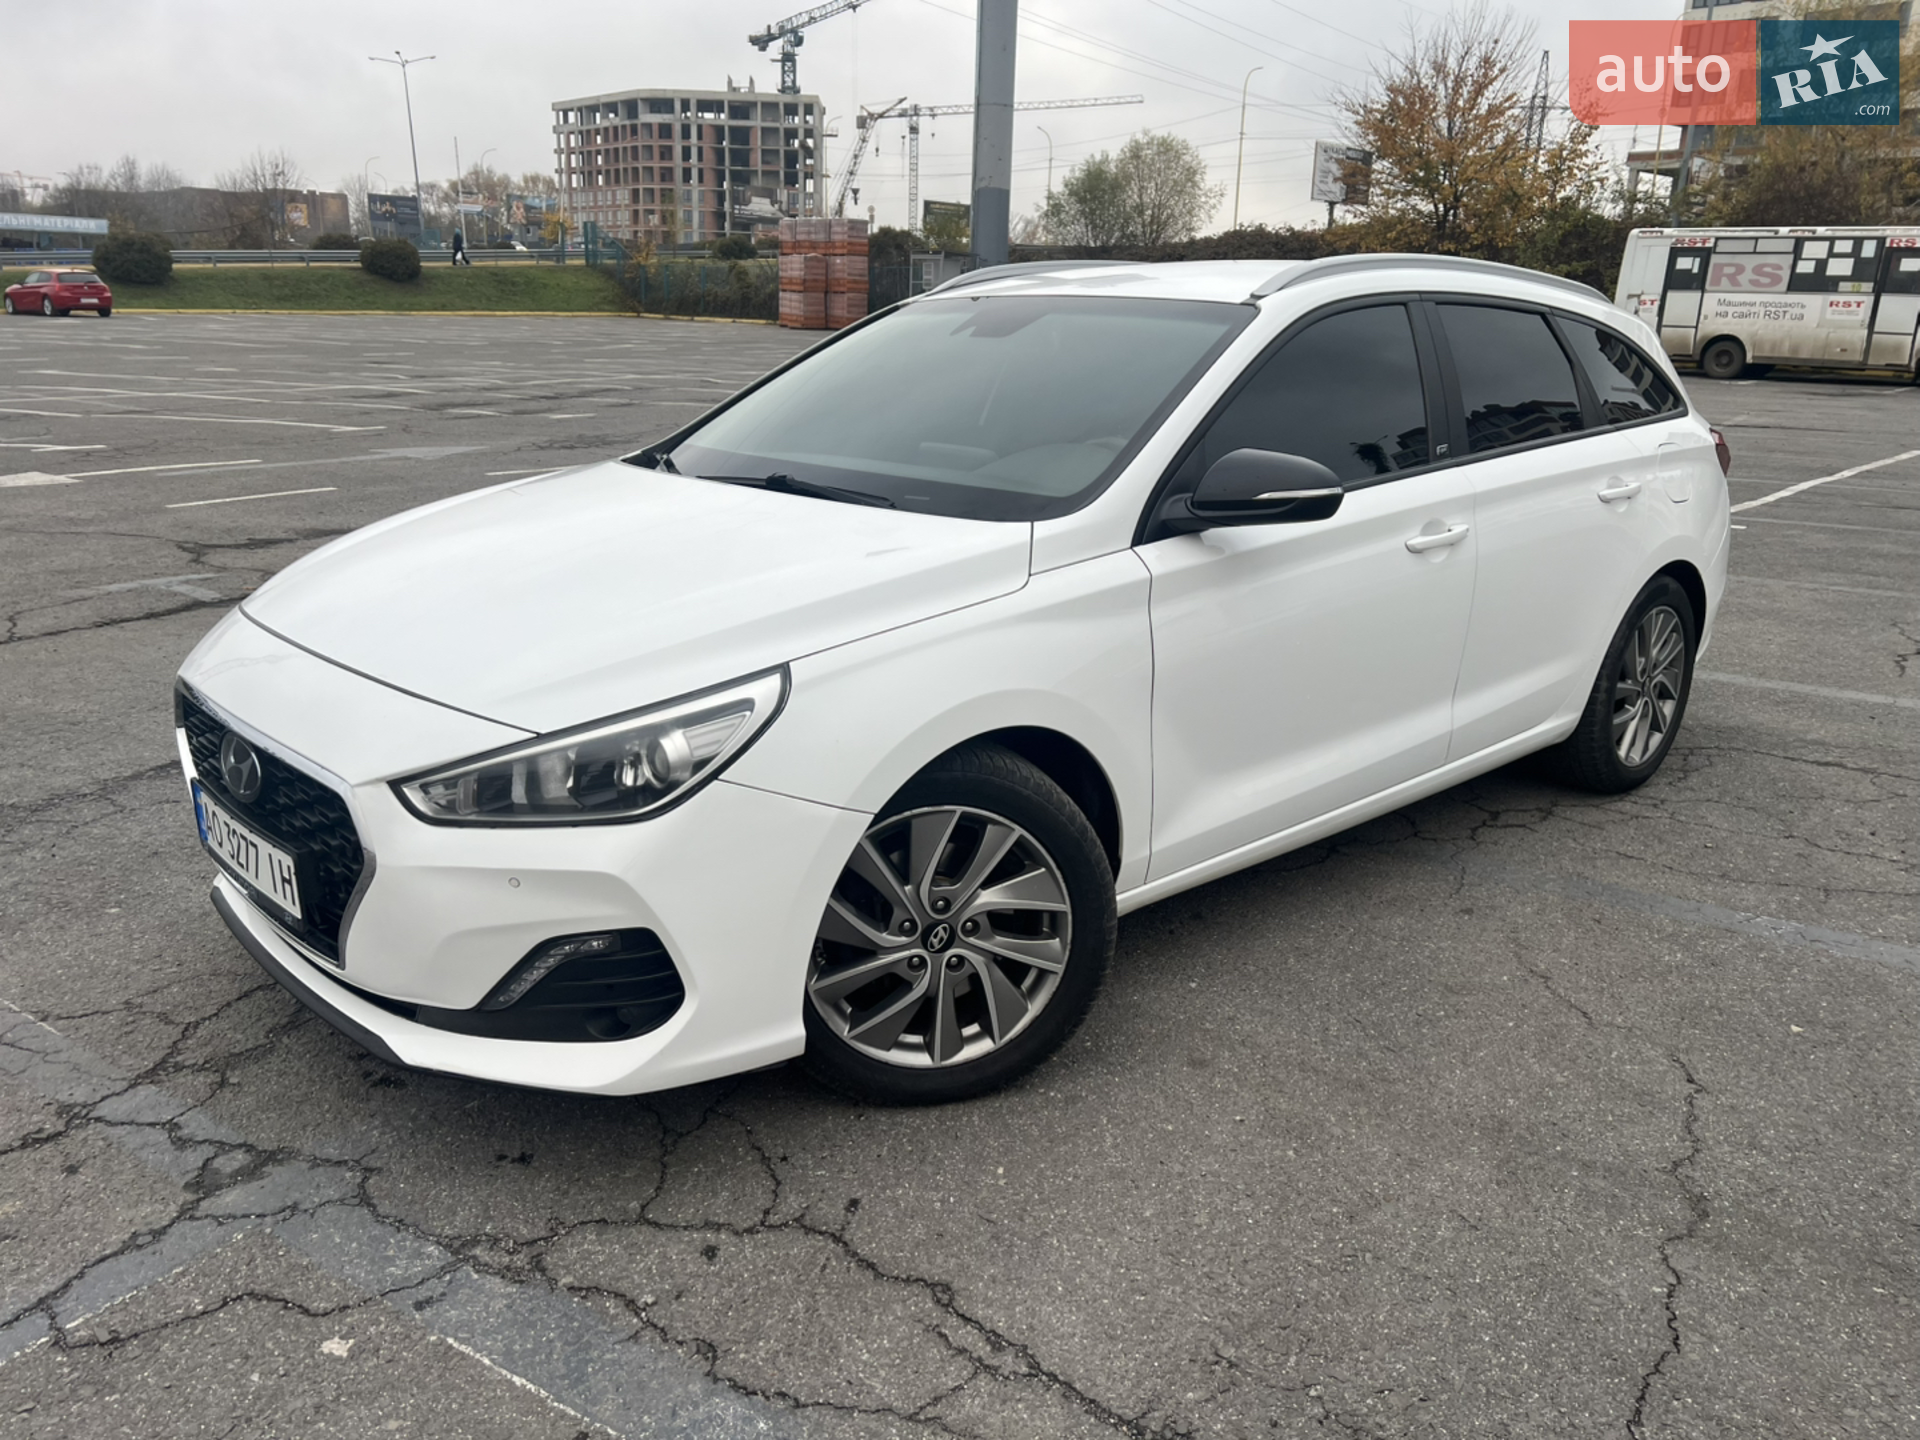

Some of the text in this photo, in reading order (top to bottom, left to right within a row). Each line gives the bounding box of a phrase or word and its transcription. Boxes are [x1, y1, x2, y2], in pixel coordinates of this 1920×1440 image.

[0, 214, 97, 230] ЛЬНІ МАТЕРІАЛИ
[1708, 262, 1784, 289] RS
[1716, 298, 1807, 309] Машини продають
[1829, 300, 1865, 308] RST
[1715, 309, 1805, 321] на сайті RST.ua
[204, 802, 223, 849] AO
[223, 820, 259, 880] 3277
[268, 852, 296, 907] IH
